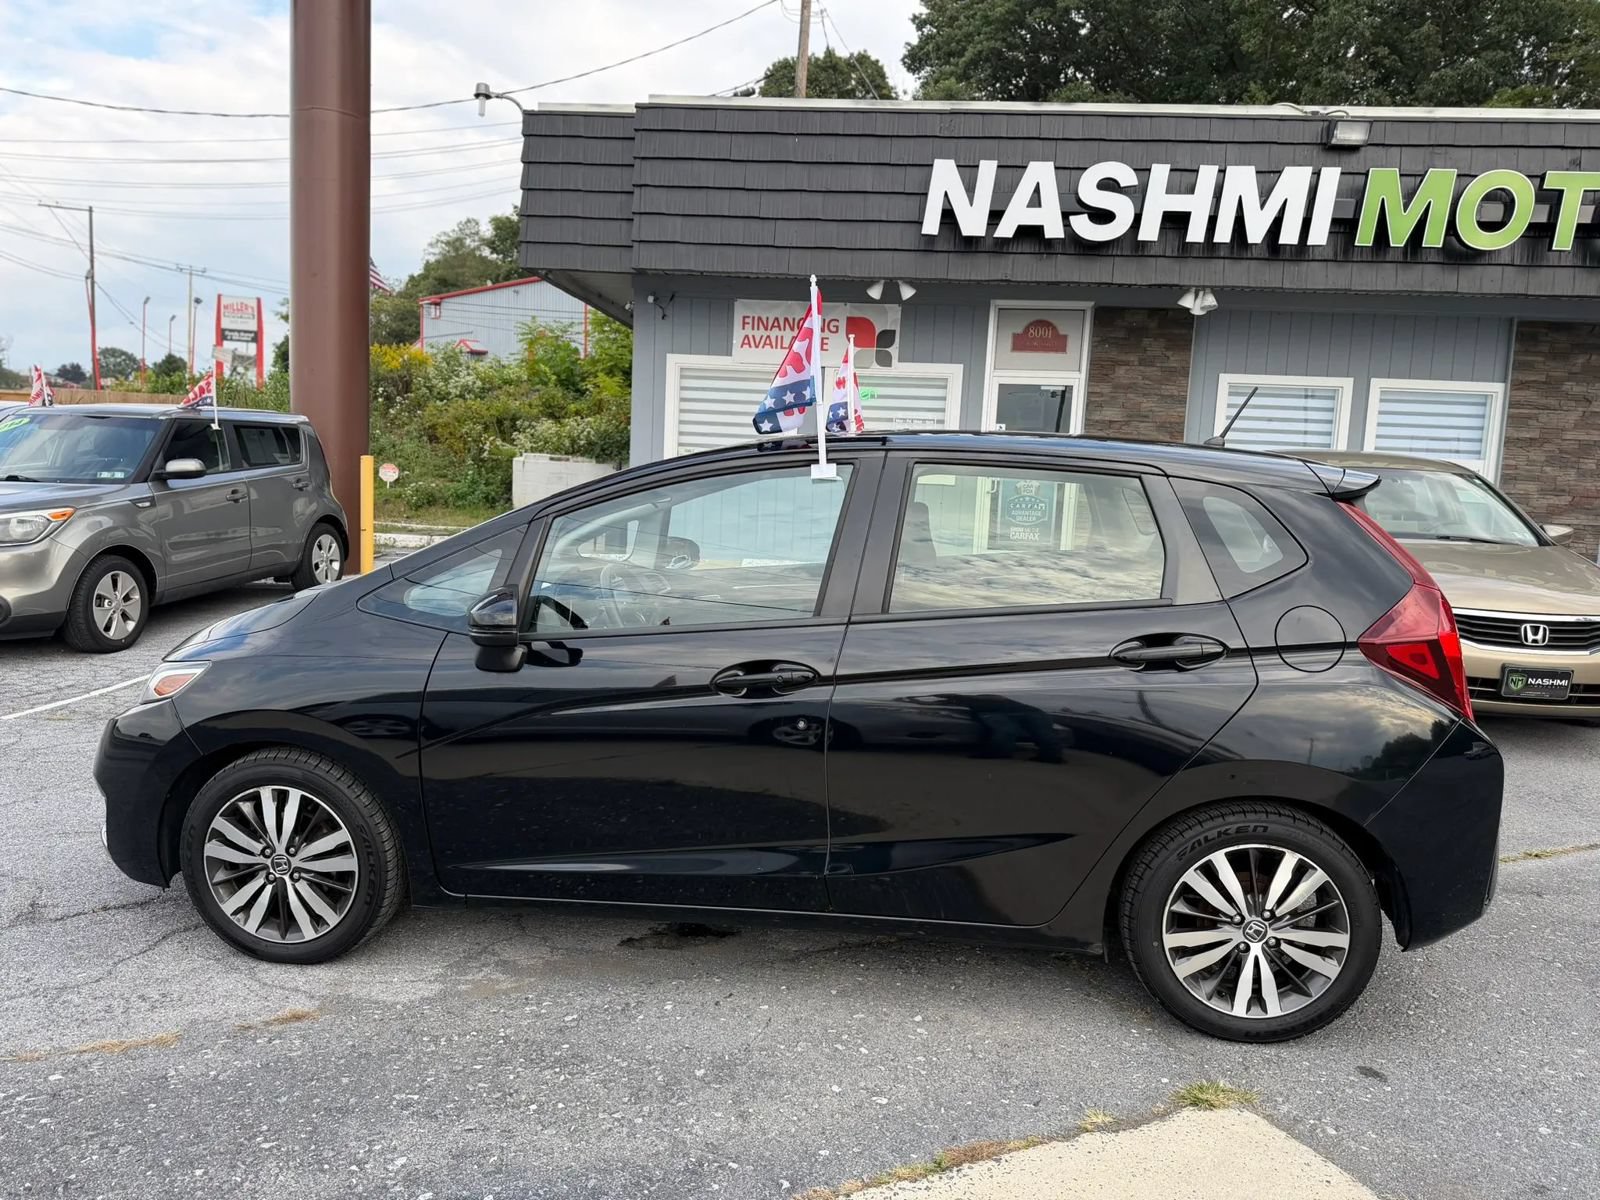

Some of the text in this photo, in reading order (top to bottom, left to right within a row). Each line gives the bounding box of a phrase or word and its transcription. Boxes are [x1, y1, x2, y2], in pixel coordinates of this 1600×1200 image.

[921, 158, 1341, 246] NASHMI
[1028, 326, 1052, 339] 8001
[1527, 678, 1568, 686] NASHMI
